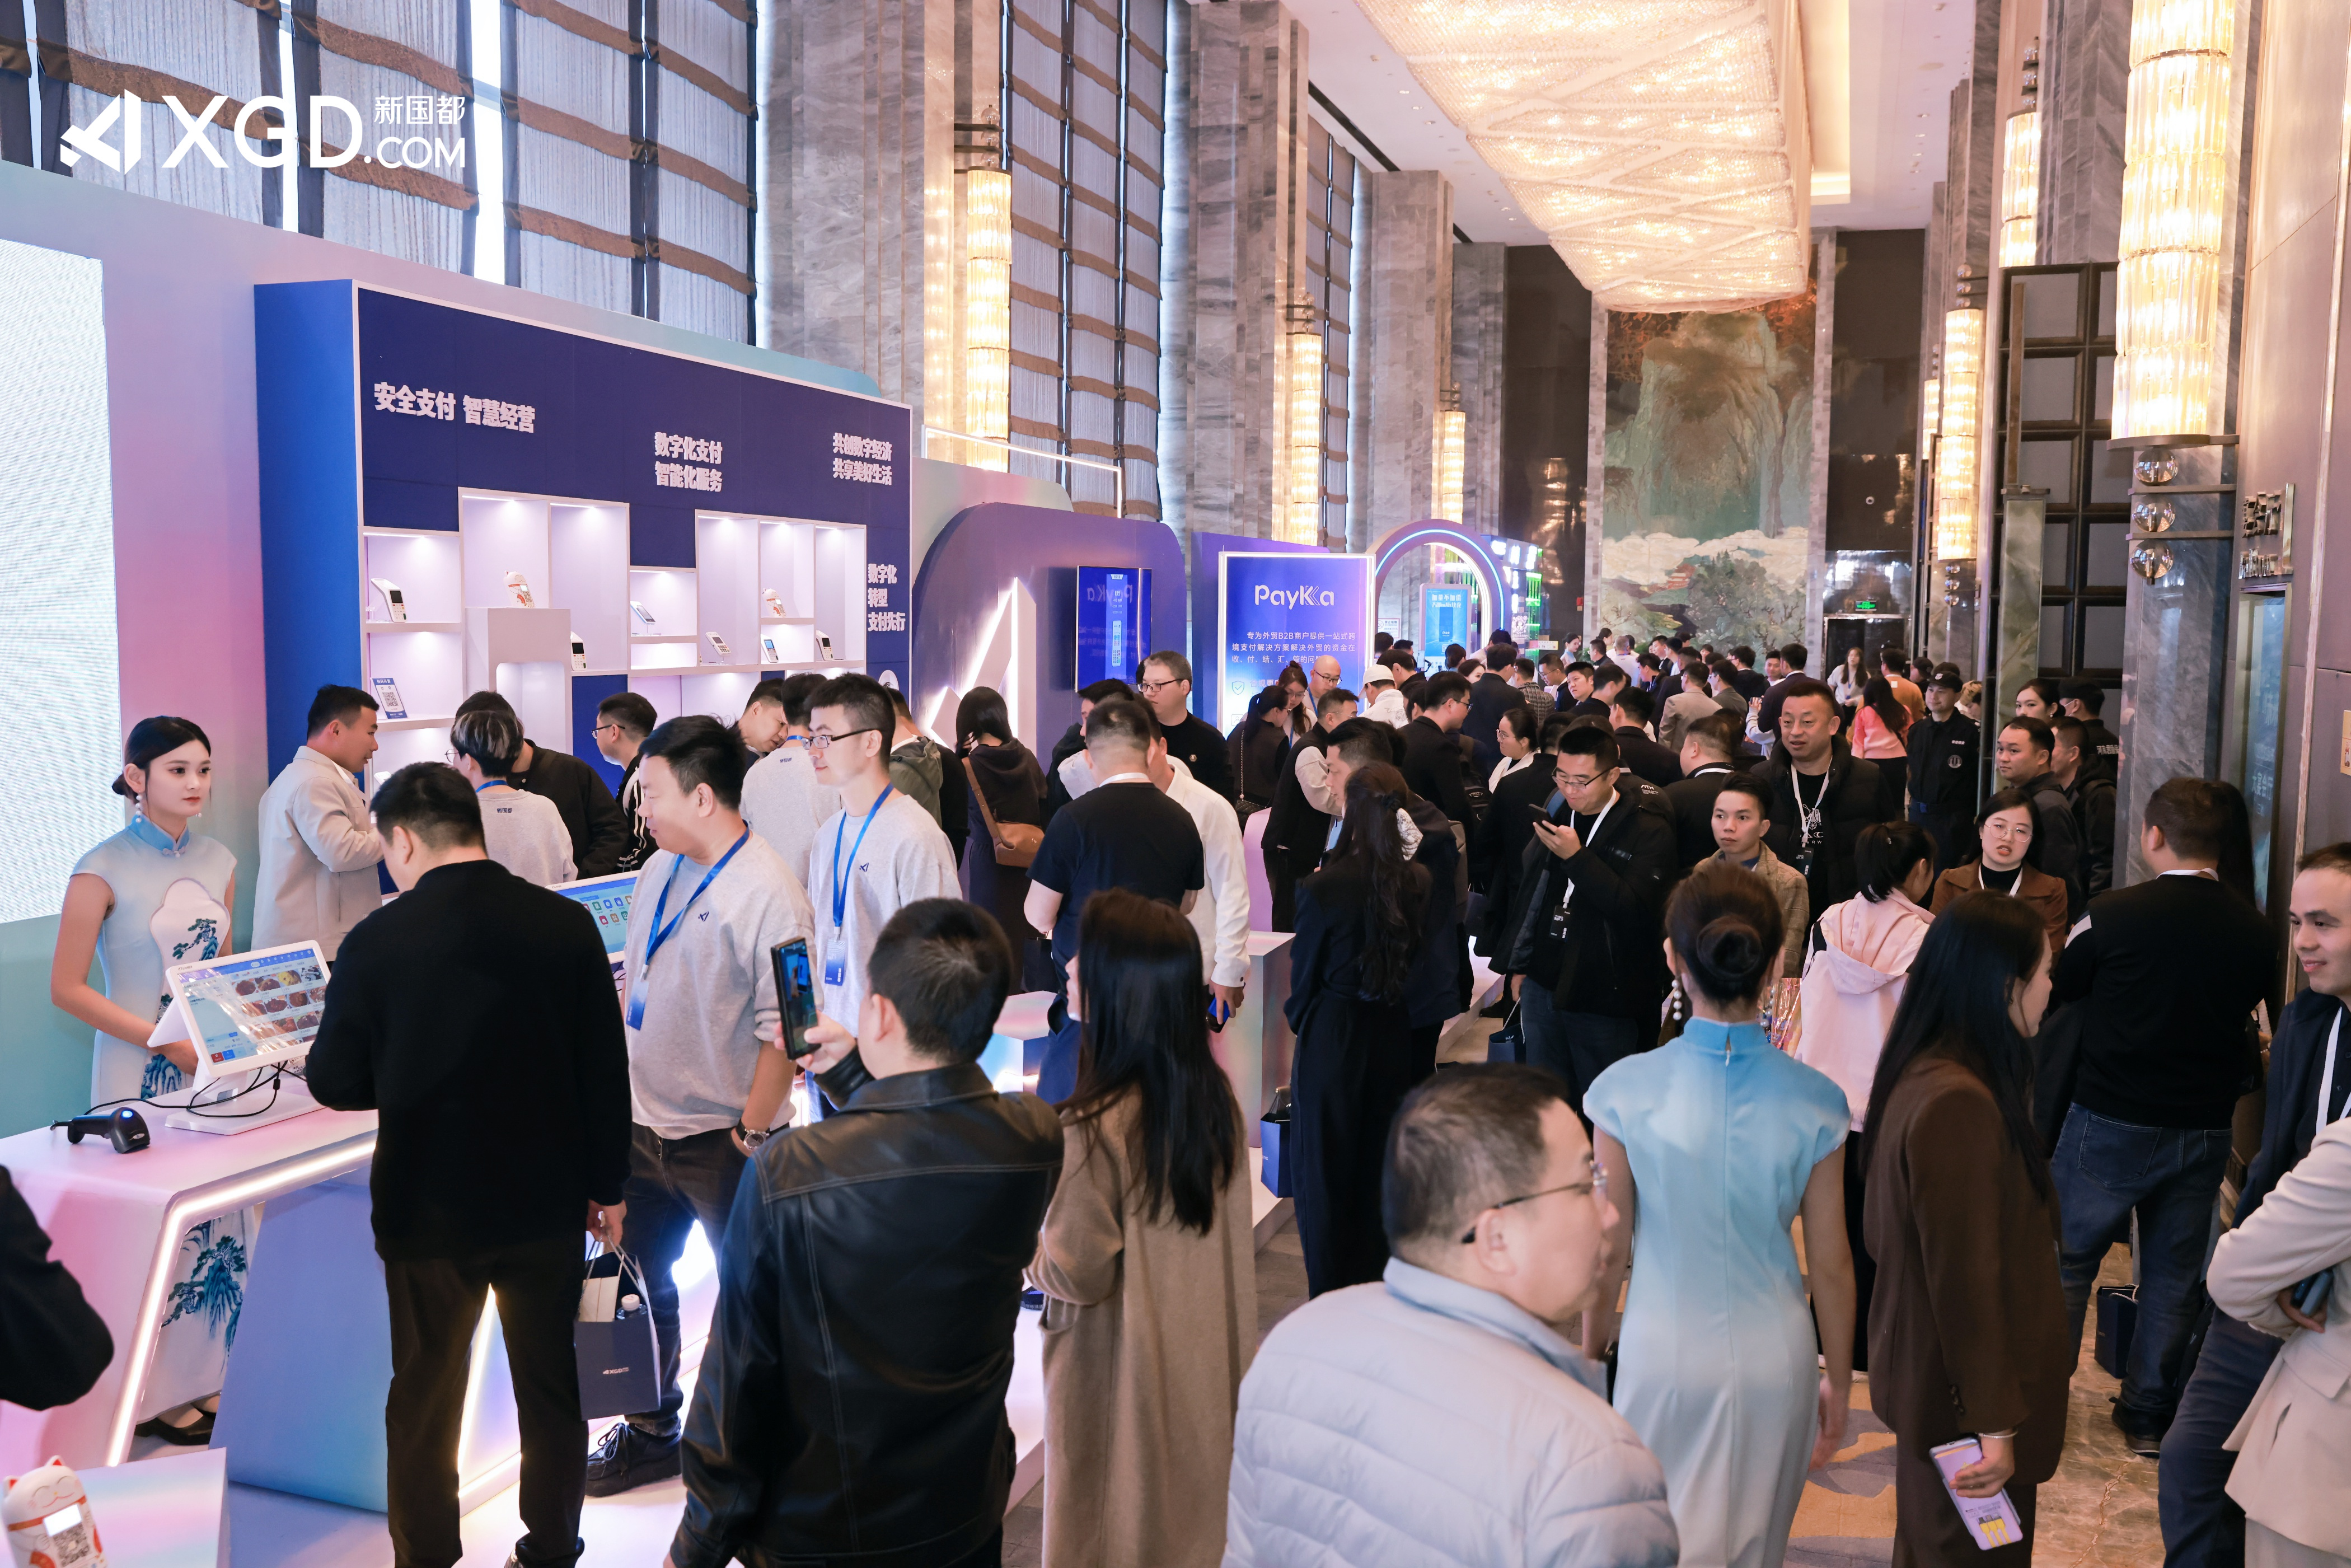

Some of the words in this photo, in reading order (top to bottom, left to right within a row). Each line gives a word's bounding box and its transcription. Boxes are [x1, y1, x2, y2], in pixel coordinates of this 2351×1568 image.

[374, 382, 456, 421] 安全支付
[462, 395, 536, 433] 智慧经营
[654, 432, 723, 465] 数字化支付
[833, 432, 892, 462] 共创数字经济
[654, 461, 723, 492] 智能化服务
[833, 458, 892, 486] 共享美好生活
[868, 564, 897, 584] 数字化
[868, 588, 888, 608] 转型
[1254, 584, 1334, 610] PayKa
[868, 612, 906, 632] 支付先行
[1231, 643, 1356, 652] 境支付解决方案解决外贸的资金在
[1247, 631, 1356, 640] 专为外贸B2B商户提供一站式跨
